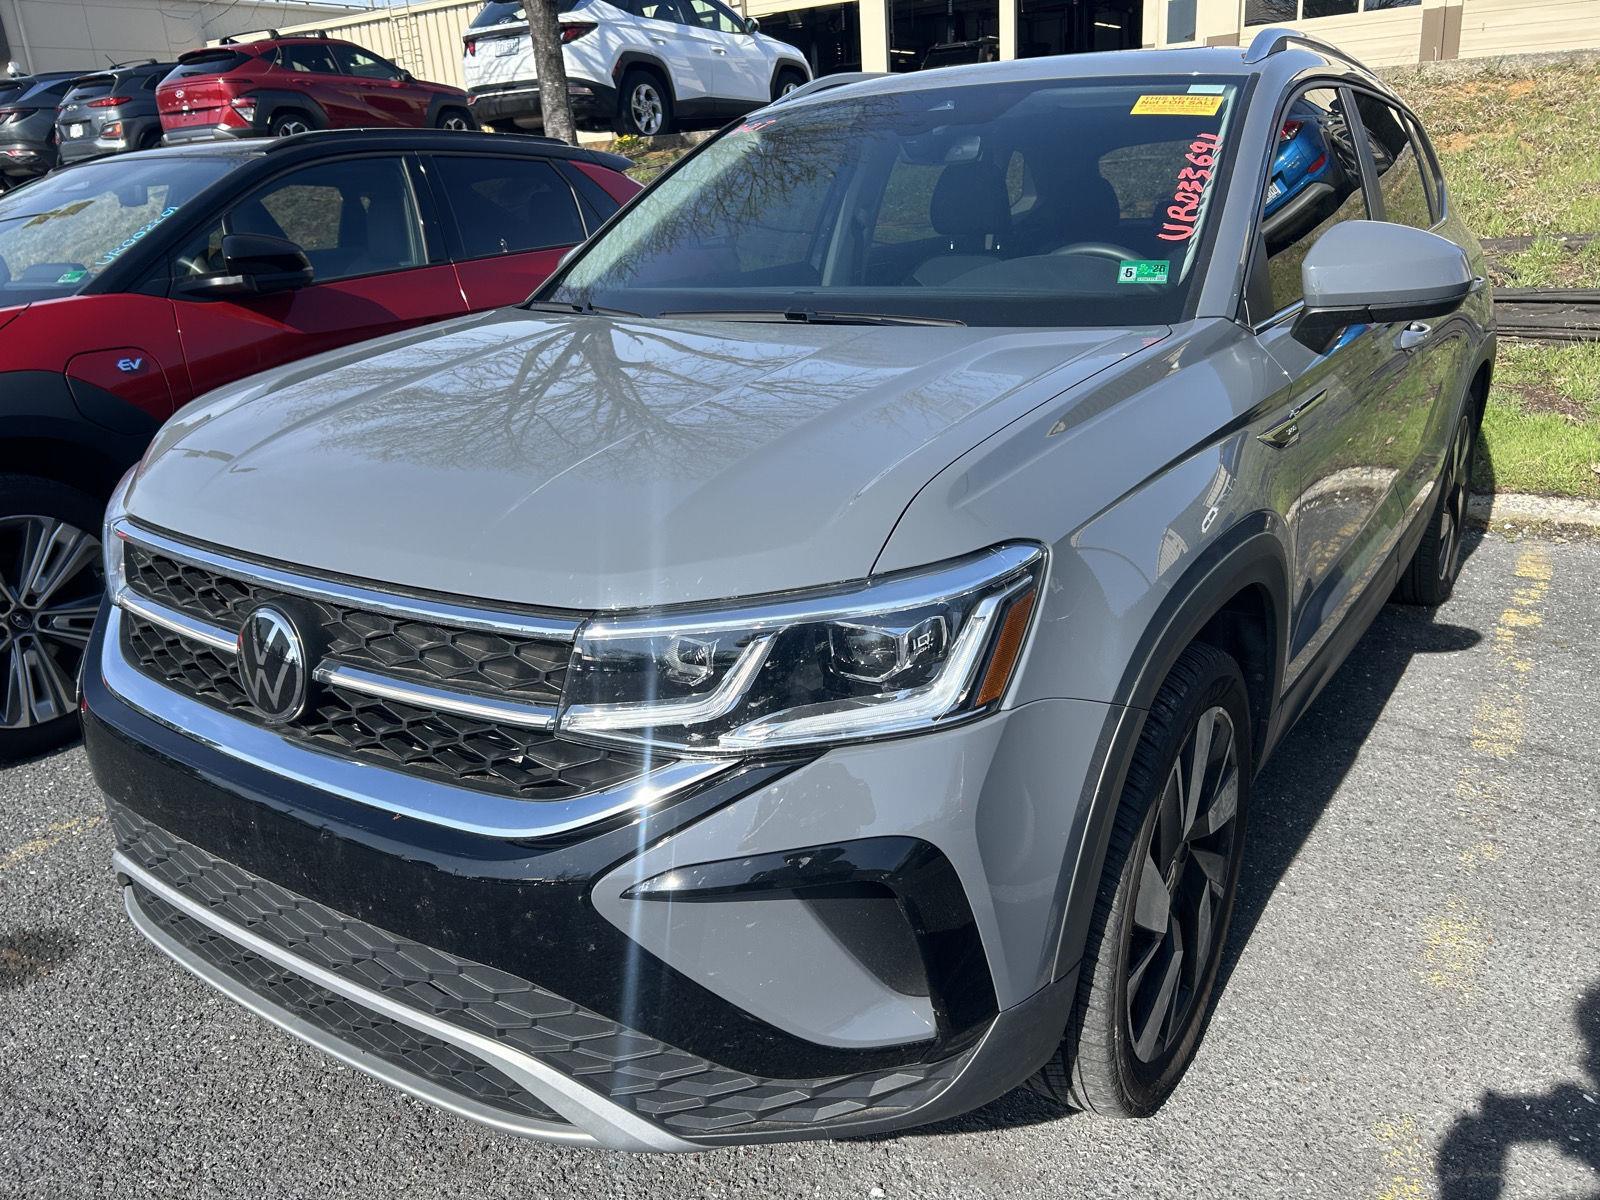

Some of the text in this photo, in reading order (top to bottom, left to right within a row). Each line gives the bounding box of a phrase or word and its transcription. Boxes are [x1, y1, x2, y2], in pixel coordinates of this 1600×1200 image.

[1156, 133, 1223, 241] UR033691
[1124, 267, 1134, 278] 5
[117, 358, 142, 371] EV
